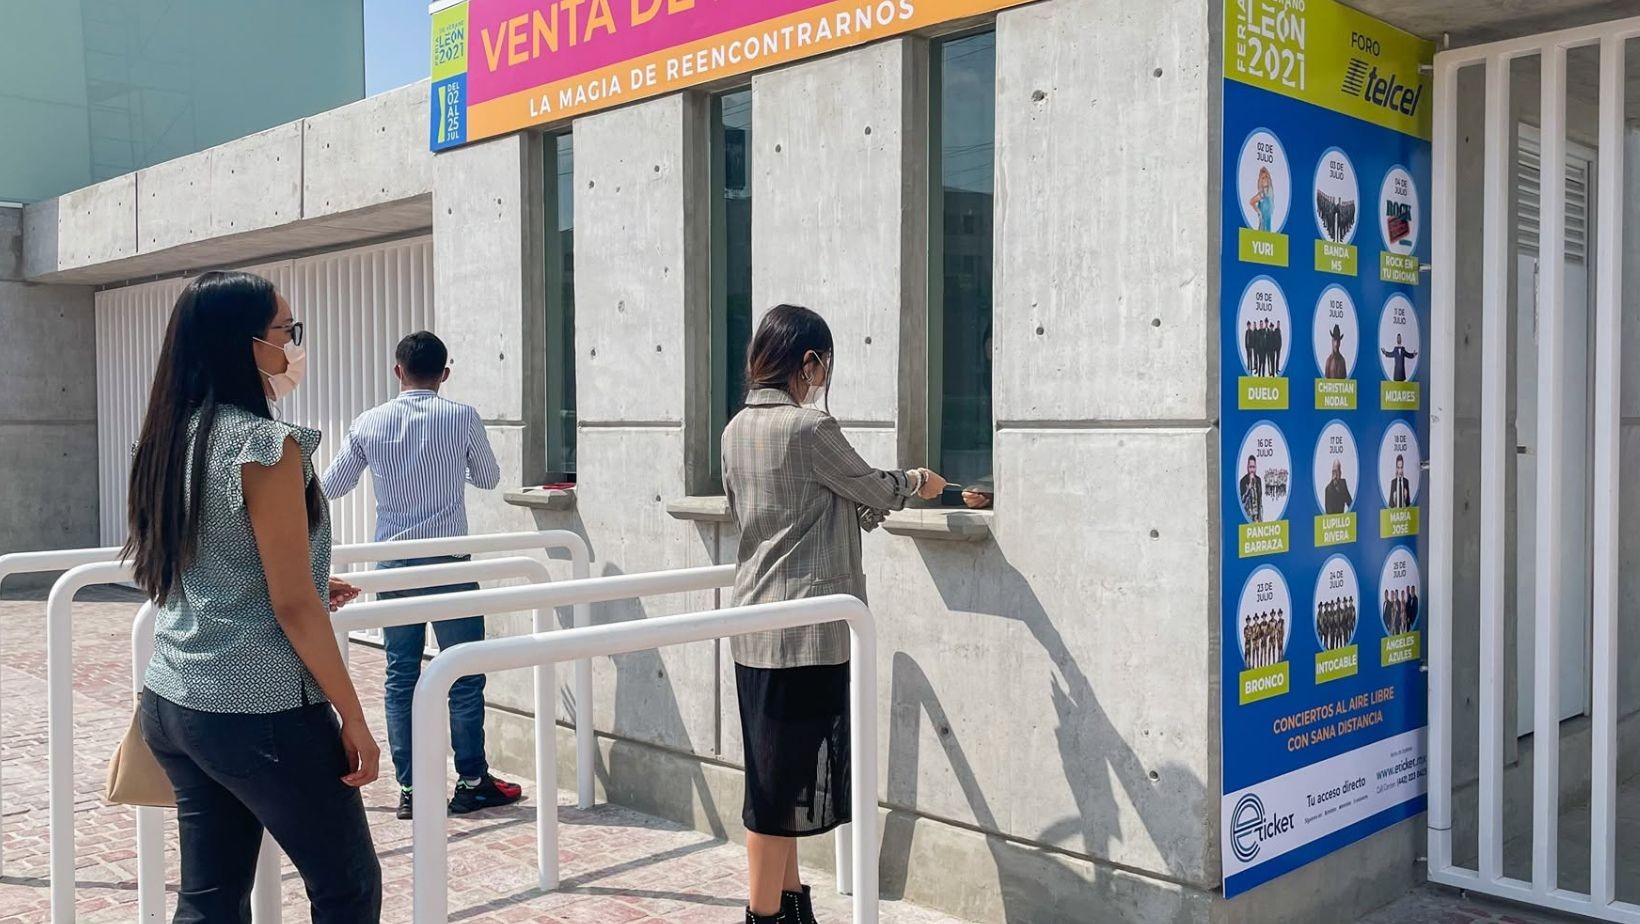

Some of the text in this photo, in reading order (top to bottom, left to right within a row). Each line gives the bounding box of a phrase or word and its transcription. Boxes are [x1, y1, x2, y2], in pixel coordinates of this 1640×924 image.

[481, 0, 617, 72] VENTA
[1351, 32, 1381, 57] FORO
[439, 42, 464, 64] 2021
[530, 0, 915, 117] LA MAGIA DE REENCONTRARNOS
[1248, 37, 1305, 91] 2021
[447, 82, 460, 92] DEL
[1363, 66, 1423, 117] telcel
[447, 91, 459, 105] 02
[447, 104, 459, 118] AL
[447, 117, 459, 131] 25
[447, 131, 459, 141] JUL
[1257, 142, 1264, 152] 02
[1257, 153, 1273, 163] JULIO
[1330, 170, 1344, 180] JULIO
[1394, 186, 1407, 196] JULIO
[1252, 241, 1274, 256] YURI
[1323, 245, 1349, 258] BANDA
[1331, 260, 1342, 271] MS
[1385, 256, 1413, 270] ROCK EN
[1383, 267, 1416, 282] TU IDIOMA
[1256, 292, 1263, 301] 09
[1256, 302, 1272, 312] JULIO
[1329, 309, 1344, 318] JULIO
[1393, 316, 1406, 325] JULIO
[1248, 387, 1279, 400] DUELO
[1318, 382, 1354, 394] CHRISTIAN
[1324, 396, 1349, 407] NODAL
[1386, 390, 1415, 402] MIJARES
[1257, 438, 1263, 448] 16
[1329, 445, 1344, 454] JULIO
[1393, 443, 1407, 452] JULIO
[1257, 448, 1273, 458] JULIO
[1322, 517, 1350, 530] LUPILLO
[1246, 525, 1281, 538] PANCHO
[1324, 530, 1349, 543] RIVERA
[1244, 538, 1283, 553] BARRAZA
[1393, 569, 1406, 578] JULIO
[1257, 583, 1263, 592] 23
[1329, 579, 1344, 589] JULIO
[1257, 591, 1273, 602] JULIO
[1388, 648, 1411, 663] AZULES
[1316, 653, 1357, 674] INTOCABLE
[1245, 673, 1284, 694] BRONCO
[1273, 686, 1394, 734] CONCIERTOS AL AIRE LIBRE
[1287, 710, 1383, 752] CON SANA DISTANCIA
[1306, 777, 1366, 807] Tu acceso directo
